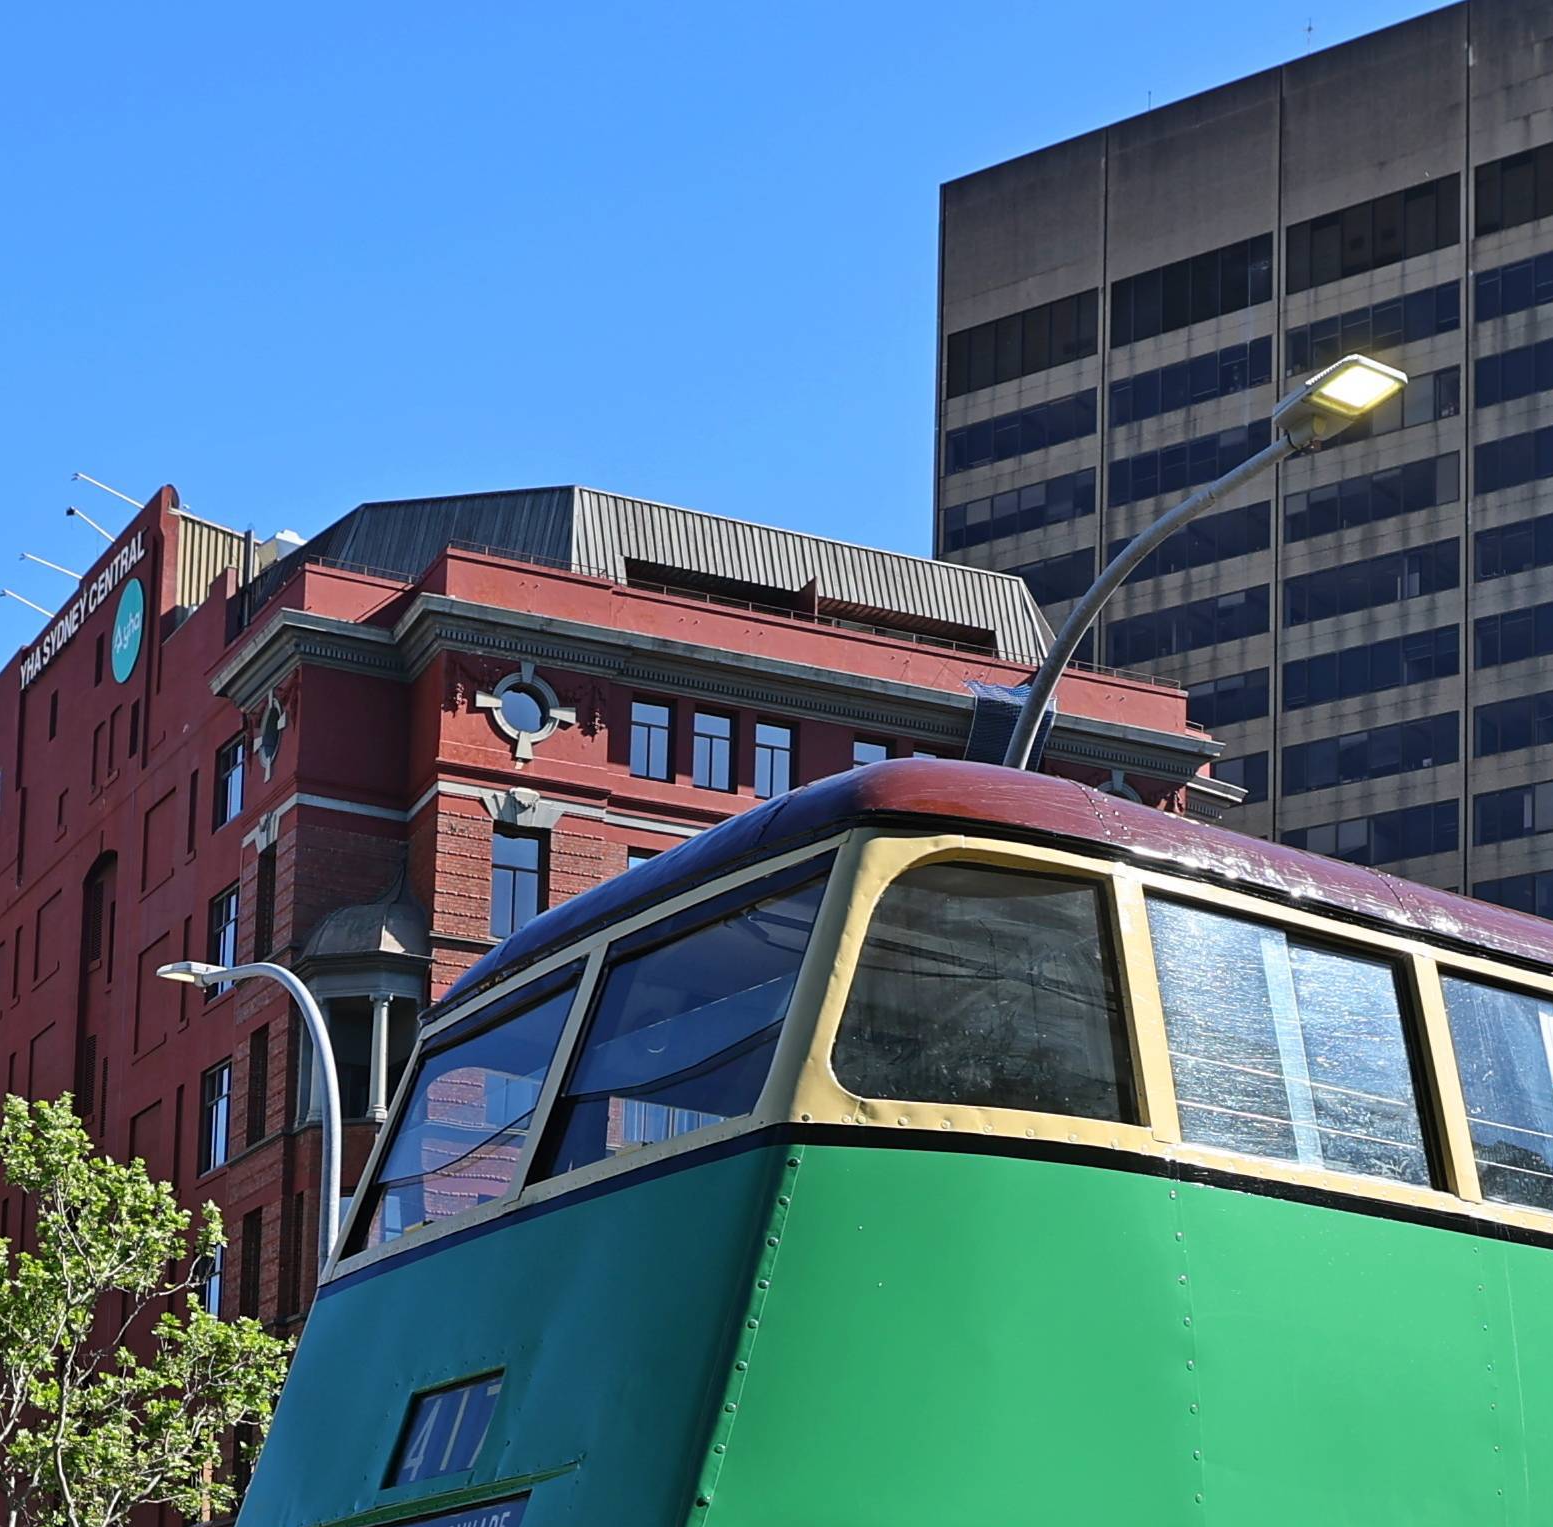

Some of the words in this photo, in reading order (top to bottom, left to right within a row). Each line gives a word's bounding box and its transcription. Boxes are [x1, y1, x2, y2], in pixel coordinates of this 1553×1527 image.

[20, 646, 42, 690] YHA
[42, 589, 88, 665] SYDNEY
[88, 531, 146, 614] CENTRAL
